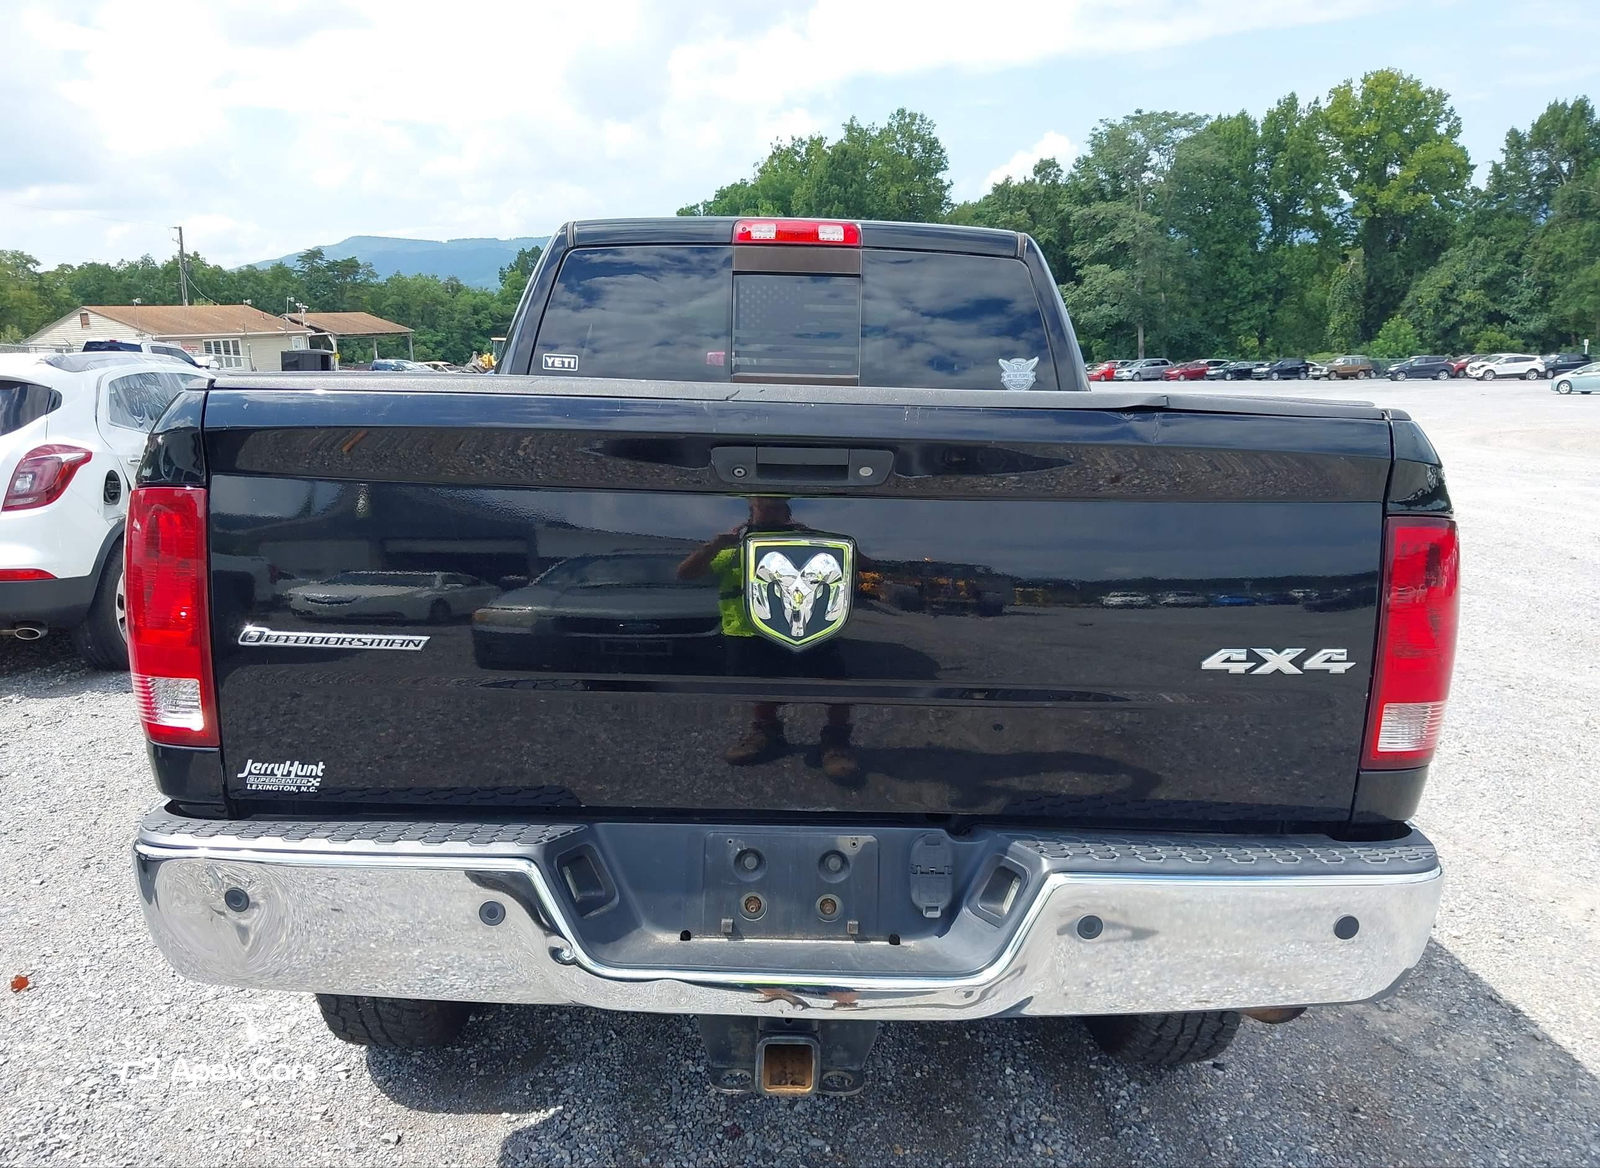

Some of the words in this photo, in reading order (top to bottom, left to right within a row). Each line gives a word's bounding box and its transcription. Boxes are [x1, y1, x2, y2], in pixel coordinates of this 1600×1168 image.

[545, 356, 576, 368] YETI
[239, 628, 426, 649] OUTDOORSMAN
[1201, 647, 1356, 675] 4X4
[248, 776, 308, 786] SUPERCENTER
[246, 784, 299, 793] LEXINGTON,
